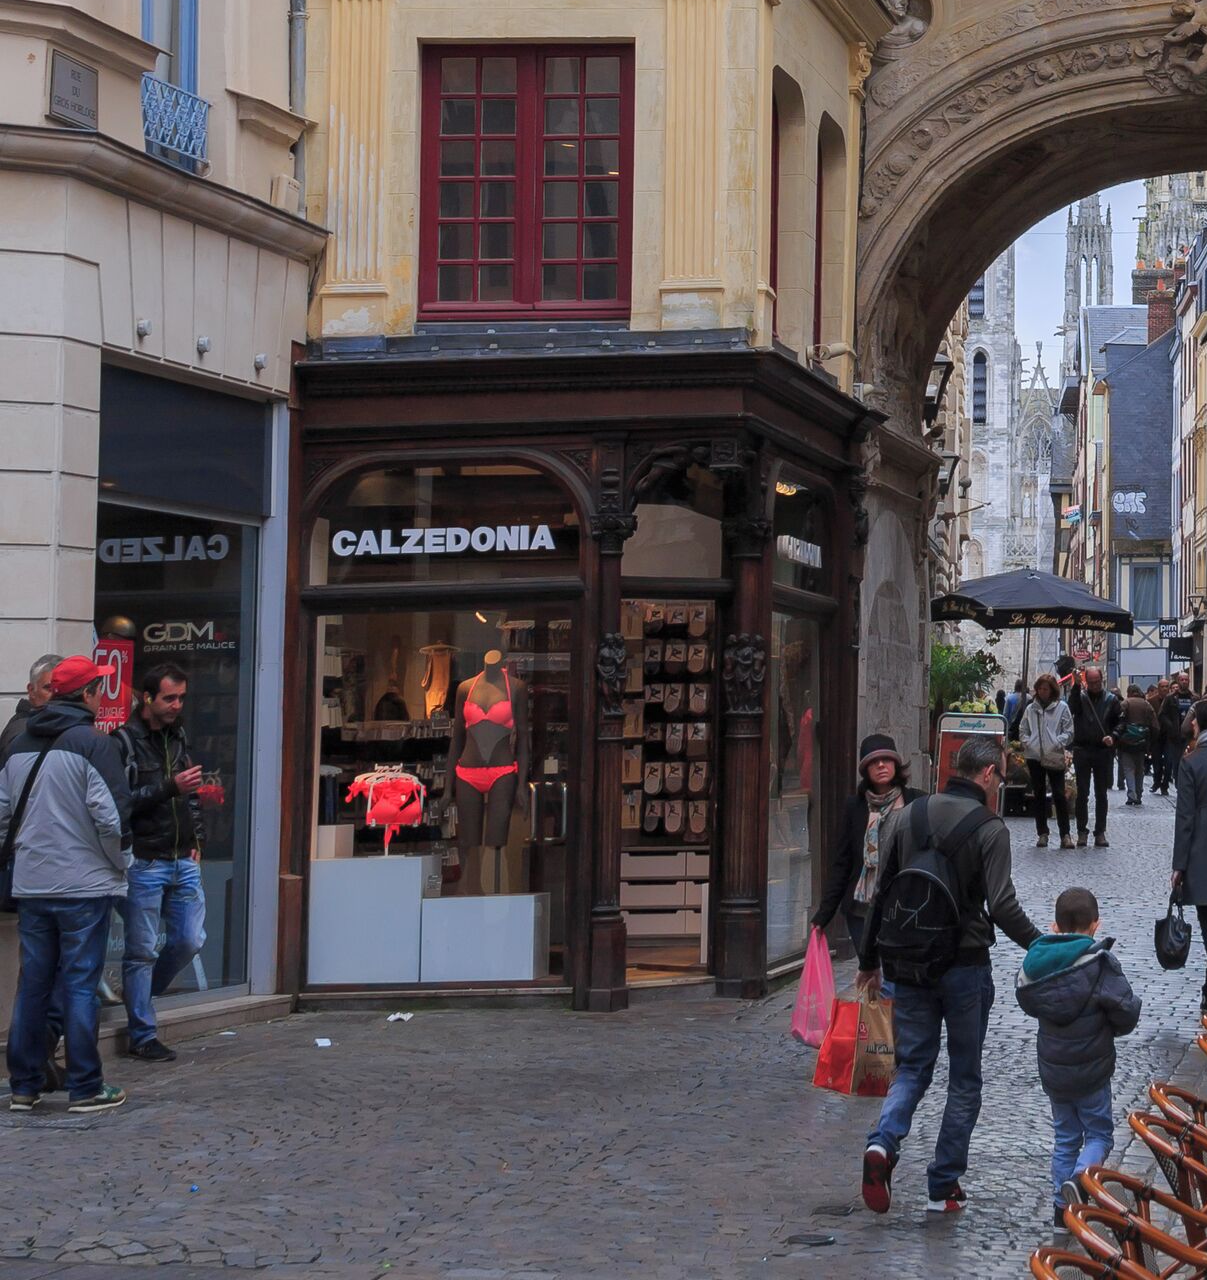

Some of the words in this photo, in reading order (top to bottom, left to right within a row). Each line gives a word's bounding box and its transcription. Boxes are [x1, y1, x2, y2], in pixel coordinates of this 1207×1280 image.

[332, 524, 557, 557] CALZEDONIA
[1009, 613, 1026, 625] Les
[1030, 612, 1059, 625] Fleurs
[1062, 614, 1074, 625] du
[1078, 614, 1117, 630] Passage
[143, 644, 177, 653] GRAIN
[179, 643, 195, 651] DE
[196, 641, 237, 650] MALICE
